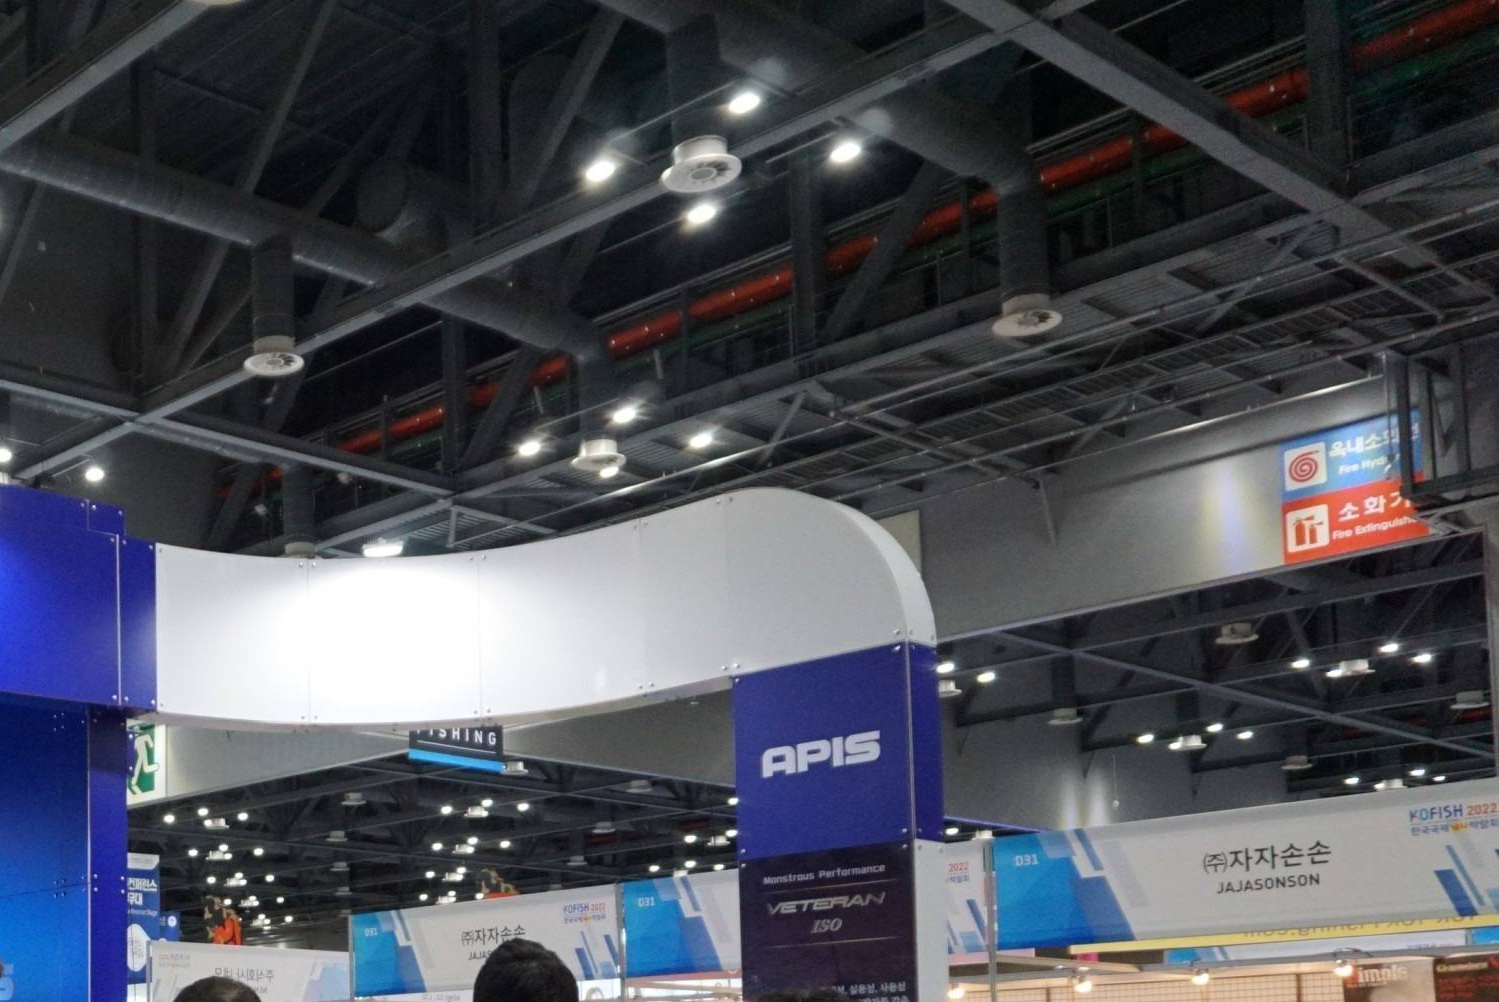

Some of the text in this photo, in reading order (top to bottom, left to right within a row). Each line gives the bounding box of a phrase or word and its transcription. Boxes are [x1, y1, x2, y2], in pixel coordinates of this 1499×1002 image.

[1332, 529, 1353, 540] Fire
[416, 727, 497, 746] ISHING
[761, 730, 881, 778] APIS
[1410, 802, 1498, 822] KOFISH 2022
[818, 864, 886, 879] Performance
[1217, 873, 1321, 894] JAJASONSON
[767, 891, 886, 915] VETERAN
